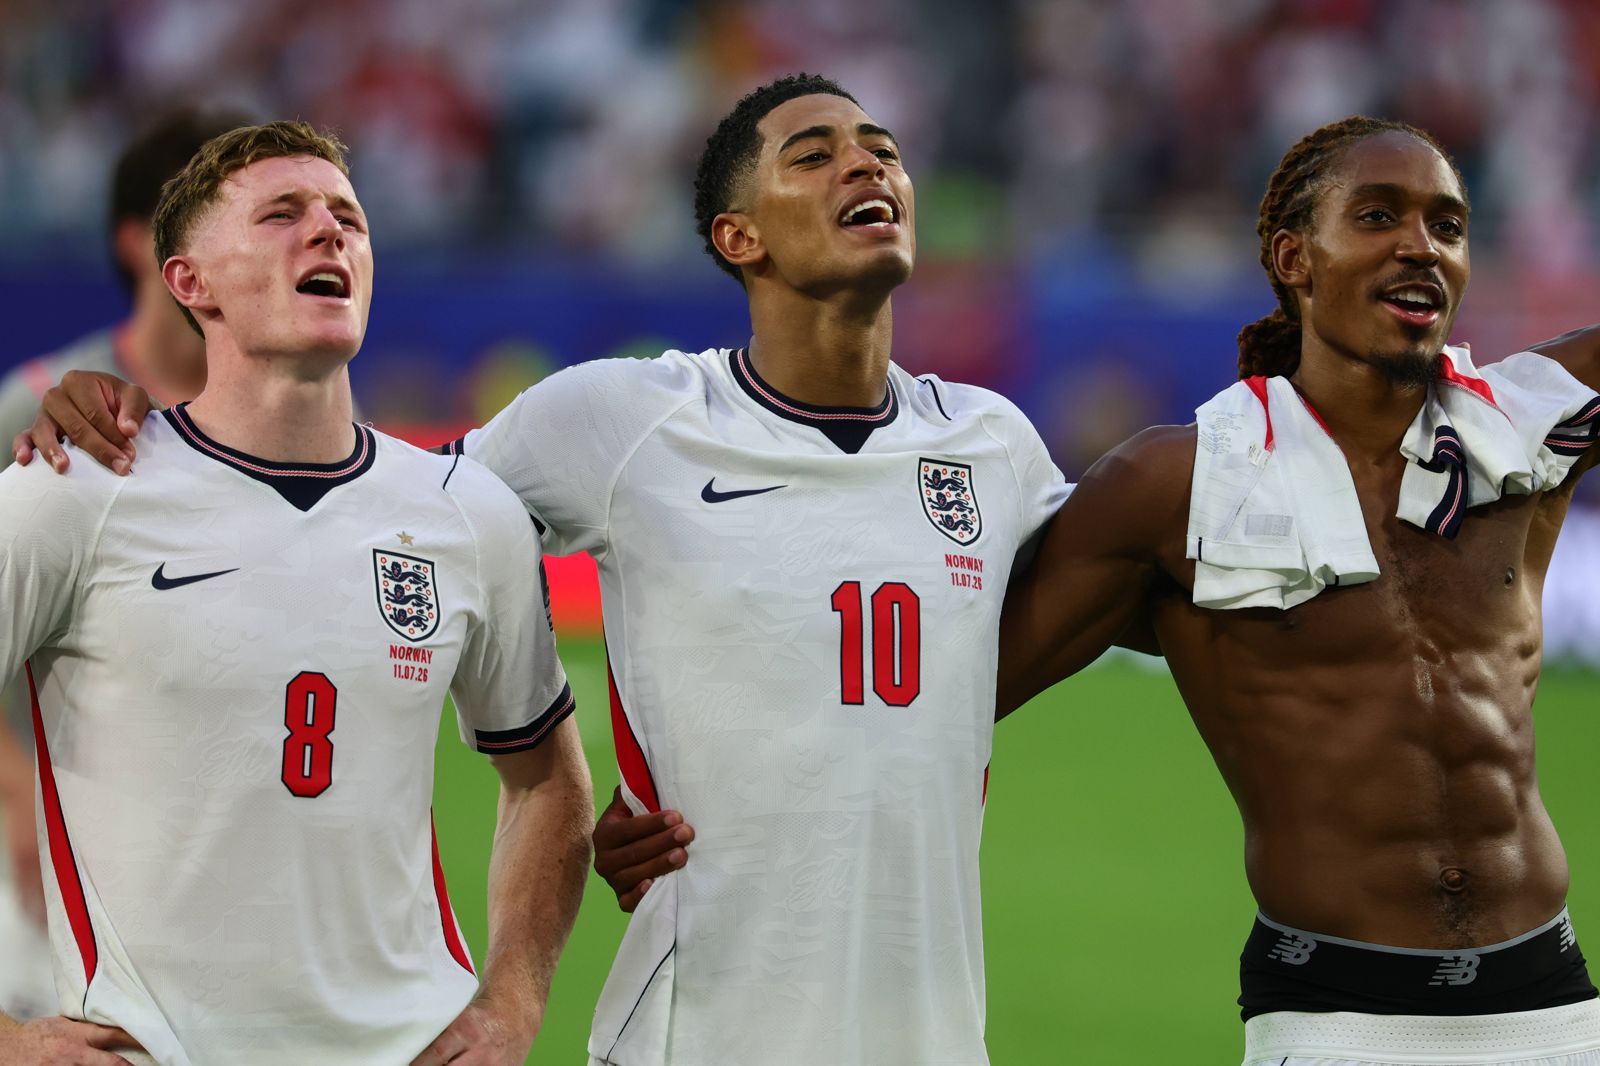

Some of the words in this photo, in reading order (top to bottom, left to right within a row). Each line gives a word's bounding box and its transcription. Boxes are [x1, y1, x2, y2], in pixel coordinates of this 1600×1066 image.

[945, 554, 983, 572] NORWAY
[951, 572, 982, 590] 11.07.26
[831, 581, 920, 707] 10
[390, 645, 432, 664] NORWAY
[394, 664, 428, 682] 11.07.26
[281, 671, 337, 798] 8
